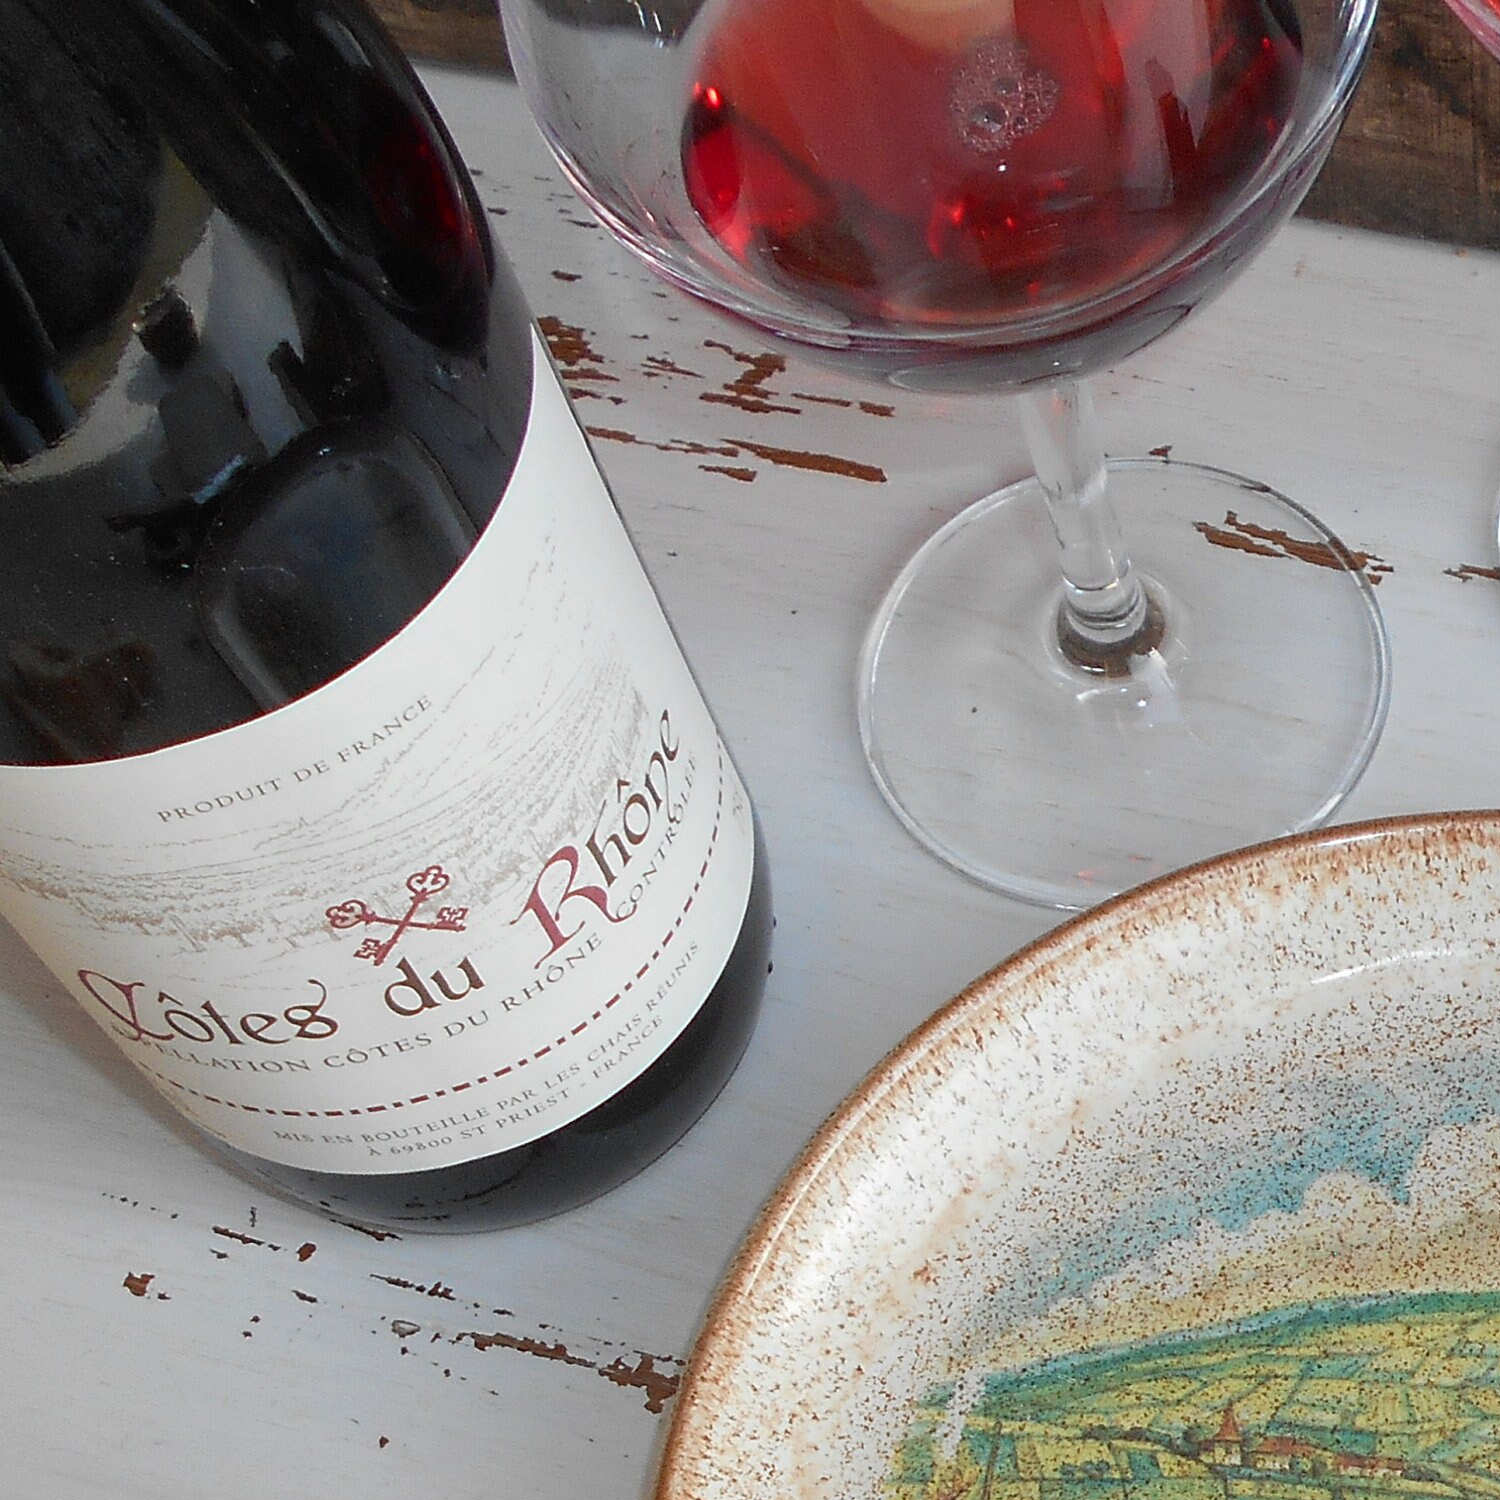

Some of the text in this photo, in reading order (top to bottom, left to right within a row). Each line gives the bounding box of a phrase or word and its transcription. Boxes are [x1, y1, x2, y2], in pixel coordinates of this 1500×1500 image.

[157, 695, 433, 823] PRODUIT DE FRANCE
[78, 709, 683, 1045] Côtes du Rhône
[274, 941, 699, 1145] MIS EN BOUTEILLE PAR LES CHAIS RÉUNIS
[324, 1031, 432, 1069] CÔTES
[443, 1010, 489, 1037] DU
[500, 932, 603, 1013] RHÔNE
[390, 1136, 453, 1156] 69800
[461, 1124, 487, 1141] ST
[495, 1088, 570, 1130] PRIEST
[592, 1015, 664, 1079] FRANCE
